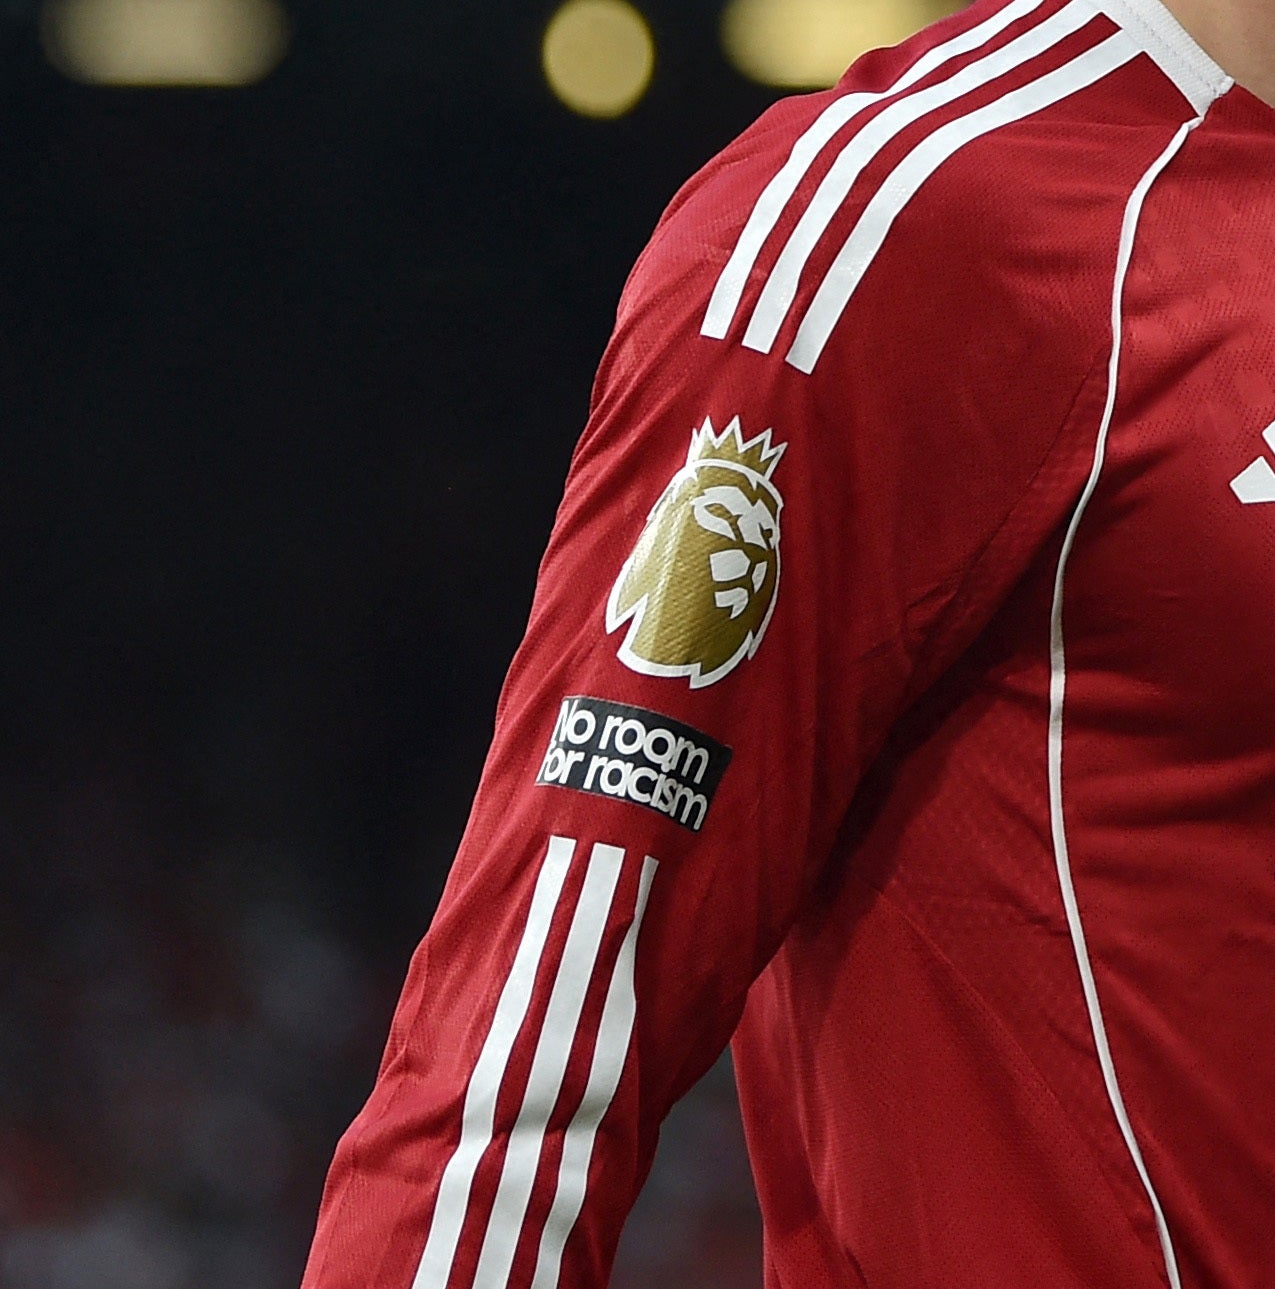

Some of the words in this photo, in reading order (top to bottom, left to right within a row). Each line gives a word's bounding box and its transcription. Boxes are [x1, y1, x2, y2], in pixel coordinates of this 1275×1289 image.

[551, 699, 596, 745] No
[598, 715, 709, 804] room
[583, 754, 708, 830] racism
